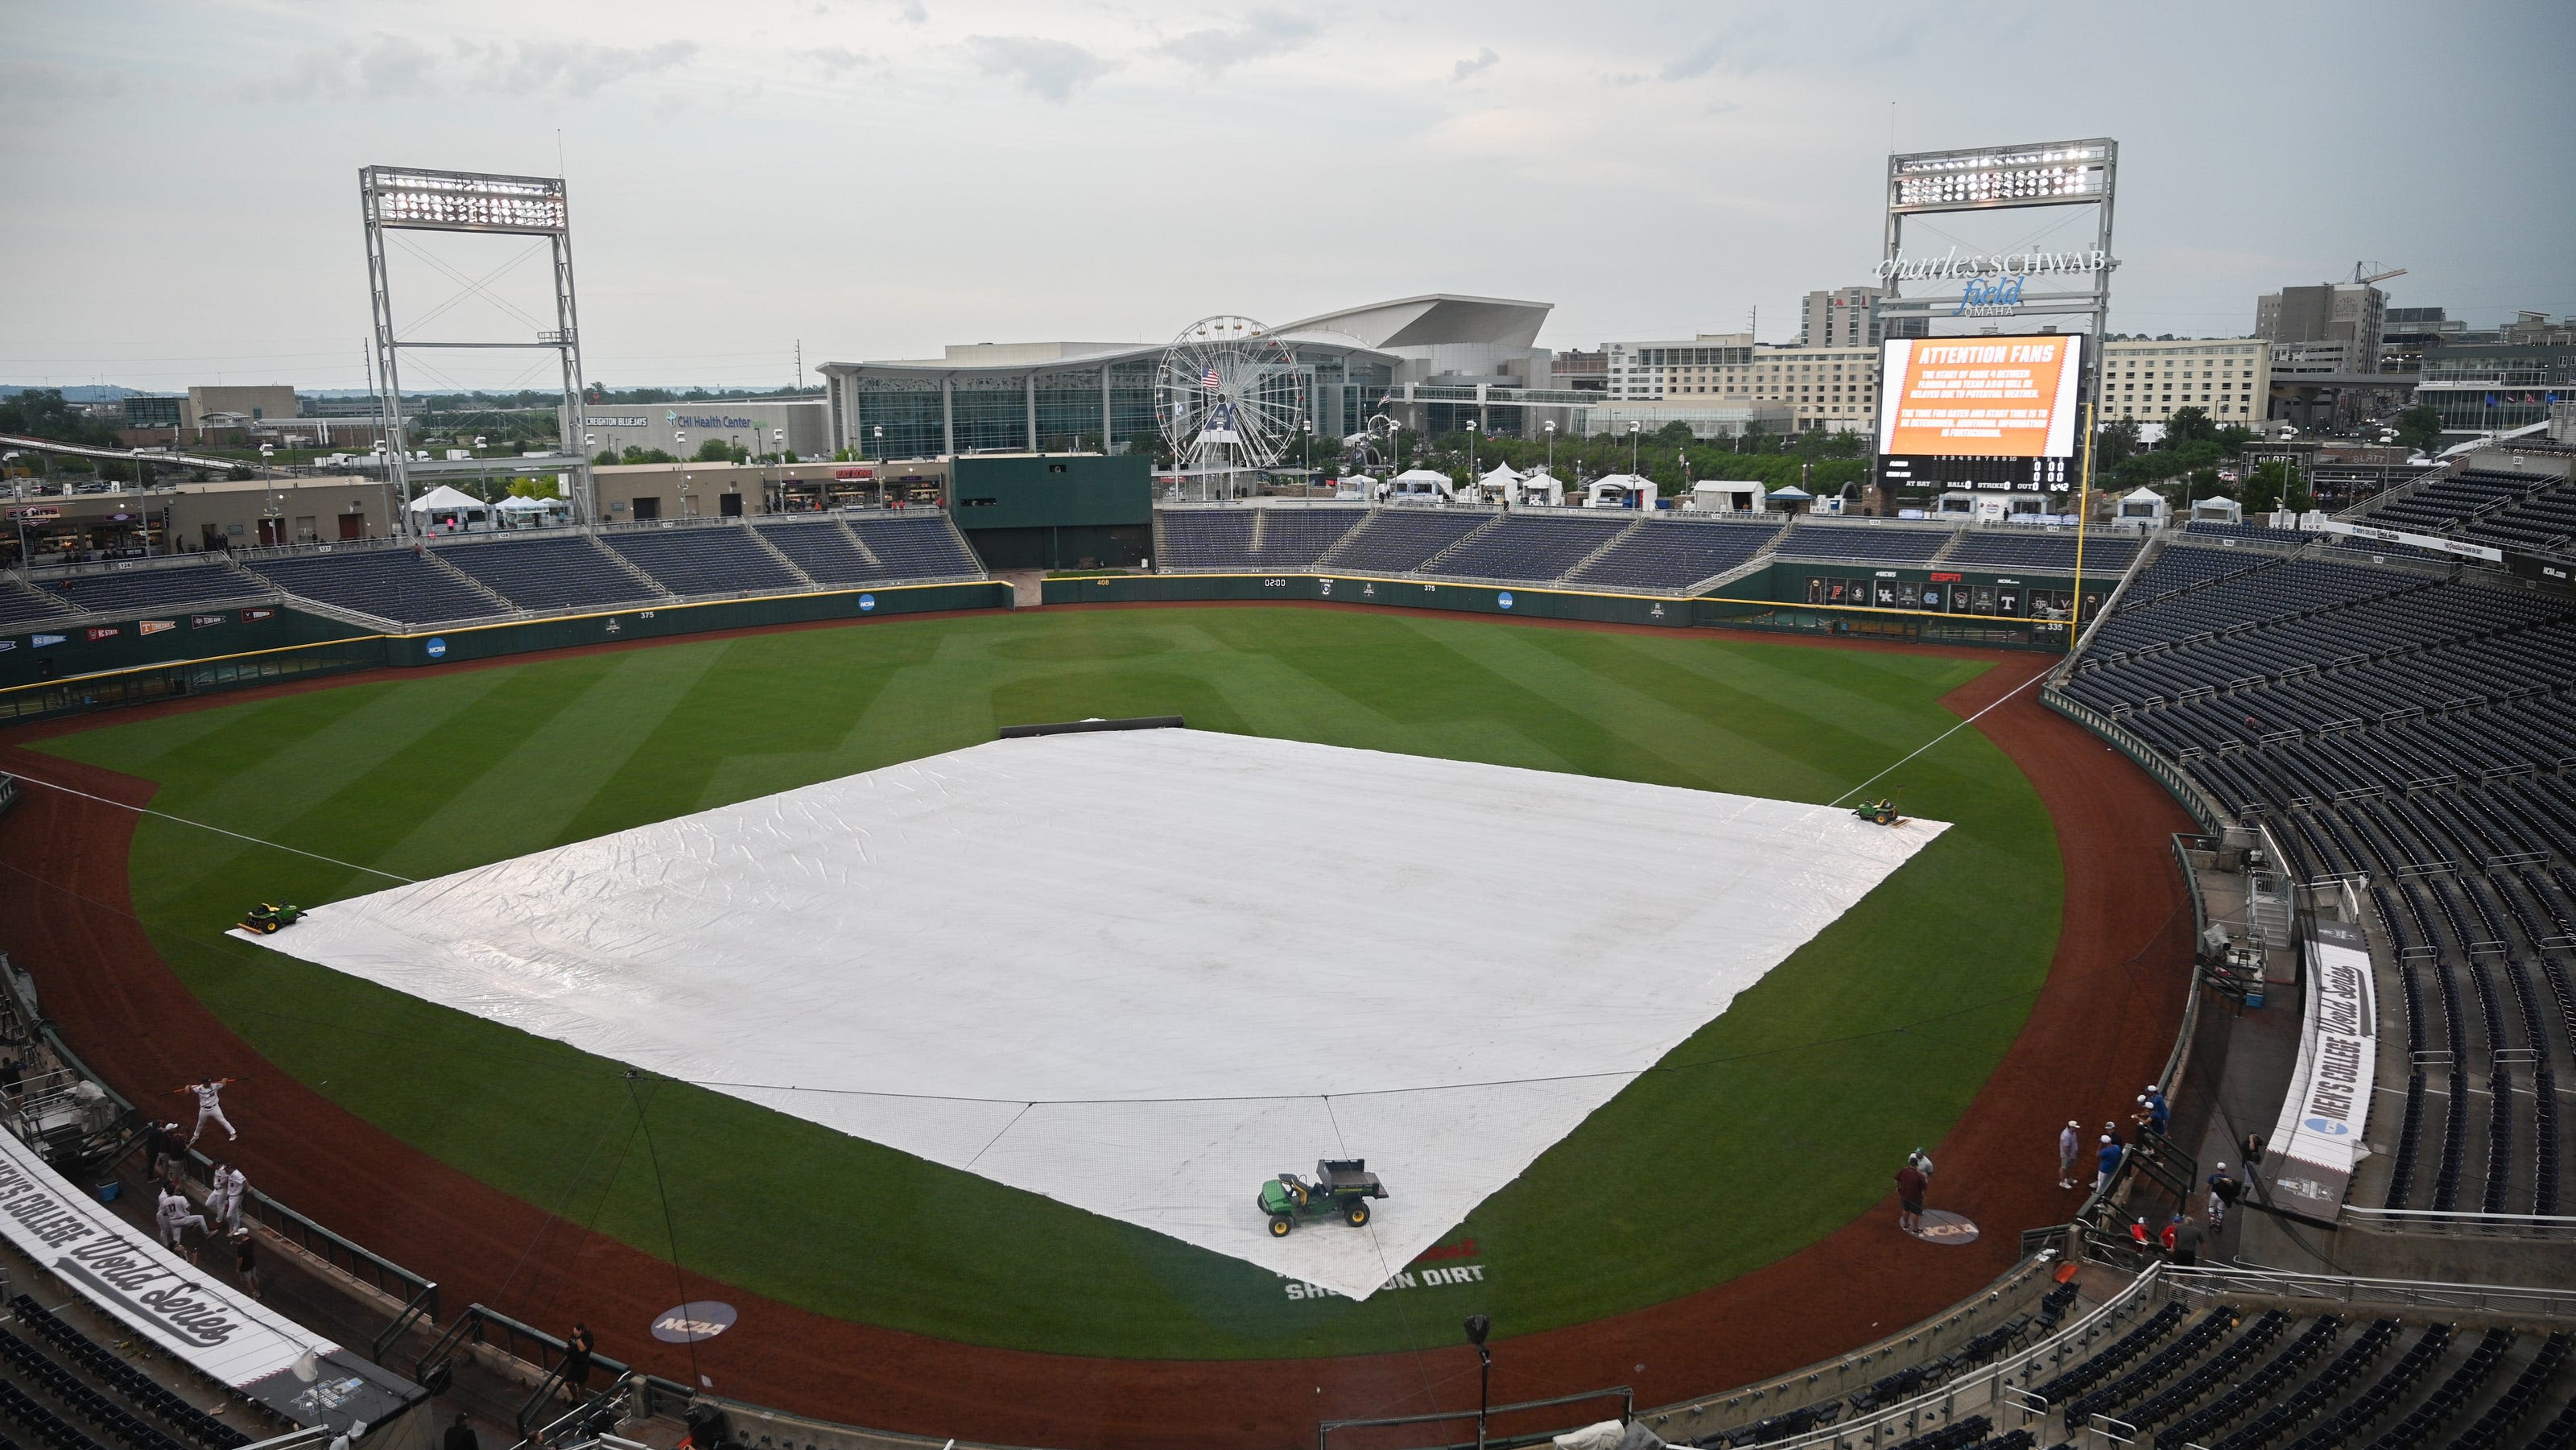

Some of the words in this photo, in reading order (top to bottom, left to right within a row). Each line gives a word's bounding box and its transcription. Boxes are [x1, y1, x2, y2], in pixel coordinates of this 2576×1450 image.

[1876, 246, 1984, 279] charles
[1989, 250, 2105, 275] SCHWAB
[1952, 276, 2025, 316] field
[1964, 307, 2013, 317] OMAHA
[1919, 347, 2006, 364] ATTENTION
[2010, 345, 2054, 363] FANS
[1922, 370, 1935, 378] THE
[586, 417, 617, 426] CREIGHTON
[618, 417, 647, 426] BLUEJAYS
[678, 415, 692, 428] CHI
[694, 415, 722, 428] Health
[724, 416, 750, 428] Center
[2352, 454, 2385, 463] BLATT
[2034, 461, 2041, 472] 0
[2048, 461, 2055, 472] 0
[2058, 461, 2064, 472] 0
[2033, 471, 2041, 481] 0
[2047, 472, 2054, 482] 0
[2056, 472, 2064, 482] 0
[1964, 480, 1971, 490] 0
[2032, 482, 2039, 491] 0
[10, 508, 29, 518] BG
[1265, 579, 1286, 587] 02:00
[1930, 572, 1963, 583] ESPN
[1830, 585, 1843, 600] F
[2001, 596, 2015, 610] T
[640, 611, 654, 619] 375
[203, 617, 213, 625] TEXAS
[2047, 623, 2063, 631] 335
[98, 630, 105, 638] NC
[105, 629, 118, 637] STATE
[428, 646, 446, 654] NCAA
[2321, 965, 2357, 1002] Series
[2319, 1001, 2358, 1037] World
[2321, 1037, 2362, 1085] COLLEGE
[2310, 1079, 2355, 1122] MEN'S
[167, 1204, 176, 1212] 17
[3, 1192, 96, 1249] COLLEGE
[70, 1234, 175, 1291] World
[140, 1283, 239, 1343] Series
[1421, 1266, 1483, 1287] DIRT
[655, 1317, 726, 1336] NCAA
